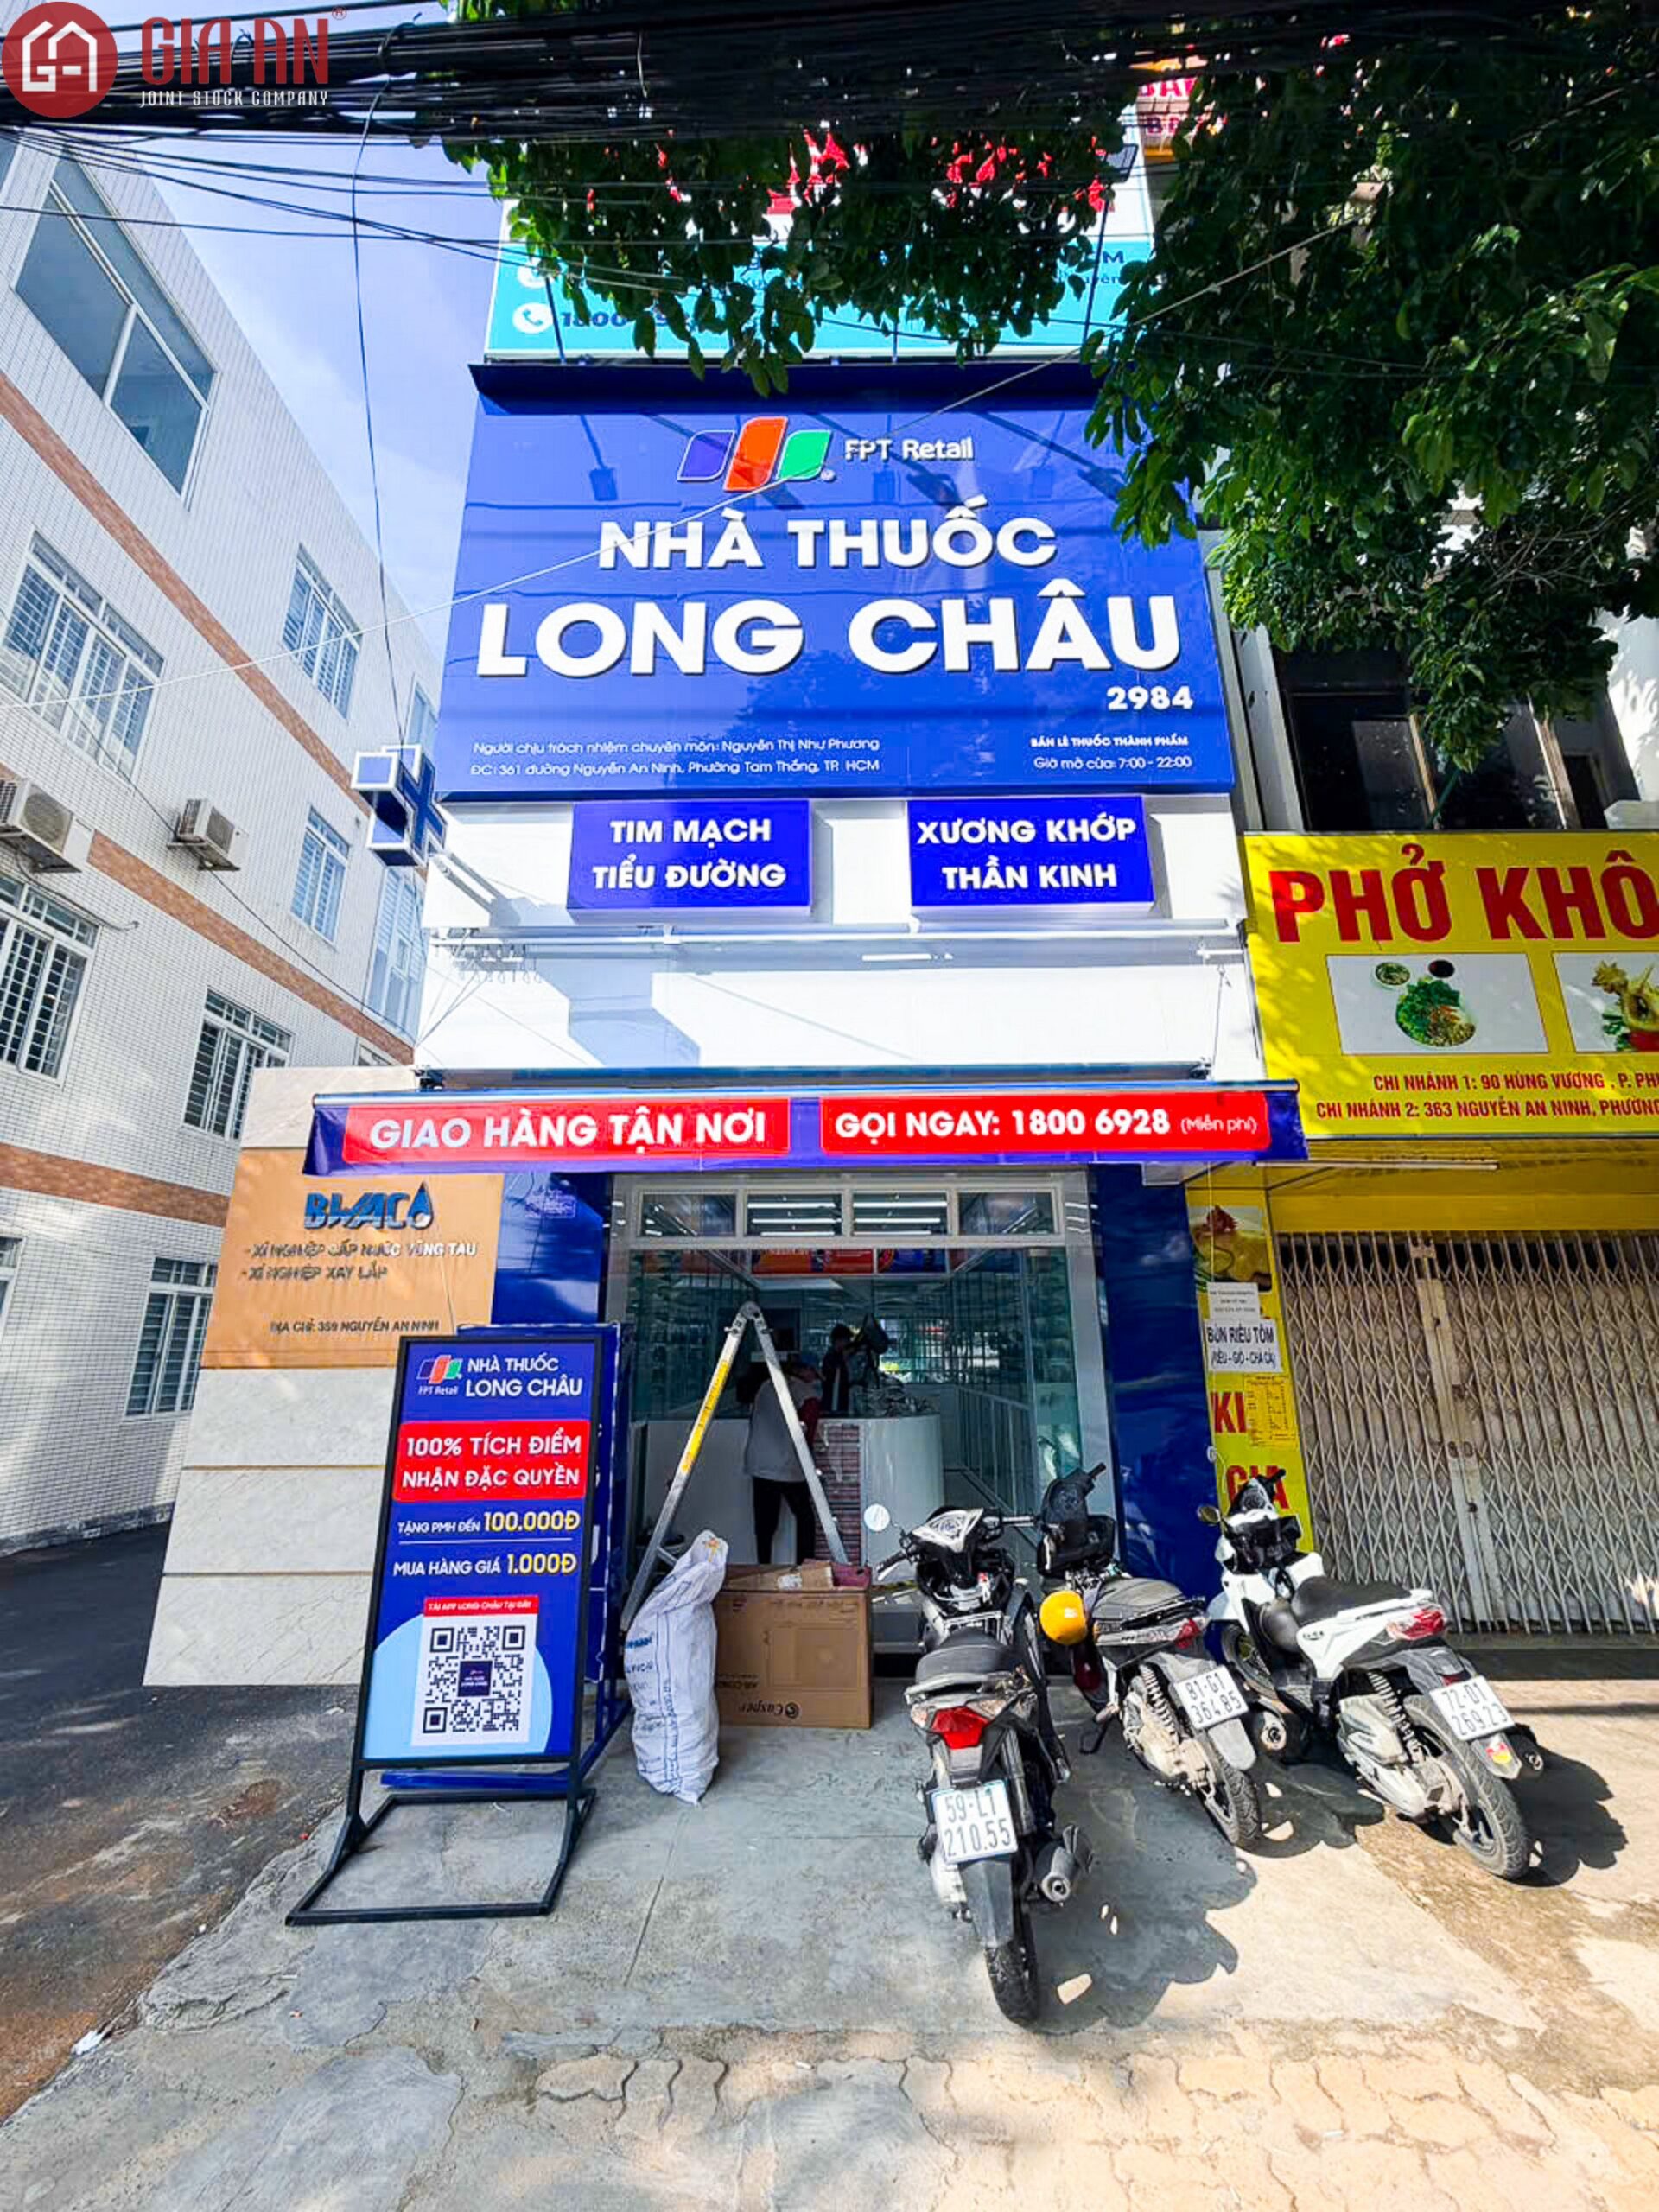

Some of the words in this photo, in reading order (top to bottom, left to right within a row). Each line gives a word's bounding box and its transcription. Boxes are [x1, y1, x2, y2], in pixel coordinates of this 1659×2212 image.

[844, 438, 891, 461] FPT
[902, 435, 975, 461] Retail
[598, 506, 763, 569] NHÀ
[787, 493, 1057, 568] THUỐC
[476, 599, 804, 677] LONG
[848, 577, 1180, 673] CHÂU
[1106, 685, 1194, 710] 2984
[721, 739, 774, 754] Nguyễn
[777, 739, 795, 753] Thị
[798, 738, 825, 751] Như
[828, 738, 880, 753] Phương
[1071, 733, 1111, 747] THUỐC
[1113, 734, 1153, 747] THÀNH
[499, 764, 521, 775] 361
[573, 760, 626, 777] Nguyễn
[628, 762, 648, 775] An
[688, 760, 741, 775] Phường
[744, 761, 773, 773] Tam
[844, 760, 880, 772] HCM
[1117, 756, 1147, 769] 7:00
[1155, 755, 1193, 769] 22:00
[610, 819, 664, 842] TIM
[673, 818, 772, 849] MẠCH
[916, 816, 1037, 844] XƯƠNG
[1046, 813, 1138, 843] KHỚP
[593, 854, 656, 889] TIỂU
[664, 858, 787, 889] ĐƯỜNG
[942, 850, 1028, 891] THẦN
[1039, 863, 1117, 888] KINH
[1268, 842, 1453, 944] PHỞ
[1373, 1075, 1401, 1092] CHI
[1404, 1071, 1461, 1092] NHÁNH
[1463, 1075, 1477, 1091] 1:
[1480, 1074, 1501, 1090] 90
[1503, 1069, 1549, 1090] HÙNG
[1551, 1071, 1605, 1090] VƯƠNG
[1315, 1102, 1344, 1120] CHI
[1347, 1098, 1401, 1119] NHÁNH
[1405, 1101, 1421, 1118] 2:
[1423, 1101, 1453, 1118] 363
[1457, 1094, 1521, 1118] NGUYỄN
[1525, 1099, 1548, 1116] AN
[1550, 1099, 1597, 1117] NINH,
[369, 1117, 472, 1149] GIAO
[483, 1108, 598, 1148] HÀNG
[609, 1106, 683, 1154] TẬN
[695, 1109, 766, 1144] NƠI
[835, 1111, 896, 1145] GỌI
[905, 1109, 1001, 1138] NGAY:
[1011, 1109, 1084, 1135] 1800
[1095, 1108, 1171, 1135] 6928
[1179, 1116, 1224, 1135] (Miễn
[1226, 1116, 1258, 1135] phí)
[467, 1354, 501, 1373] NHÀ
[505, 1351, 560, 1371] THUỐC
[465, 1380, 523, 1398] LONG
[527, 1373, 583, 1397] CHÂU
[406, 1437, 463, 1457] 100%
[469, 1432, 522, 1456] TÍCH
[528, 1427, 582, 1455] ĐIỂM
[402, 1468, 459, 1491] NHẬN
[464, 1469, 509, 1491] ĐẶC
[513, 1461, 581, 1486] QUYỀN
[397, 1521, 430, 1537] TẶNG
[431, 1521, 457, 1534] PMH
[457, 1516, 481, 1533] ĐẾN
[484, 1511, 582, 1532] 100.000Đ
[392, 1561, 426, 1577] MUA
[429, 1554, 474, 1576] HÀNG
[474, 1553, 502, 1575] GIÁ
[506, 1553, 578, 1576] 1.000Đ
[1191, 1689, 1243, 1725] 364.85
[1451, 1702, 1509, 1736] 269.23
[944, 1788, 997, 1824] 59-L1
[944, 1818, 1012, 1858] 210.55
